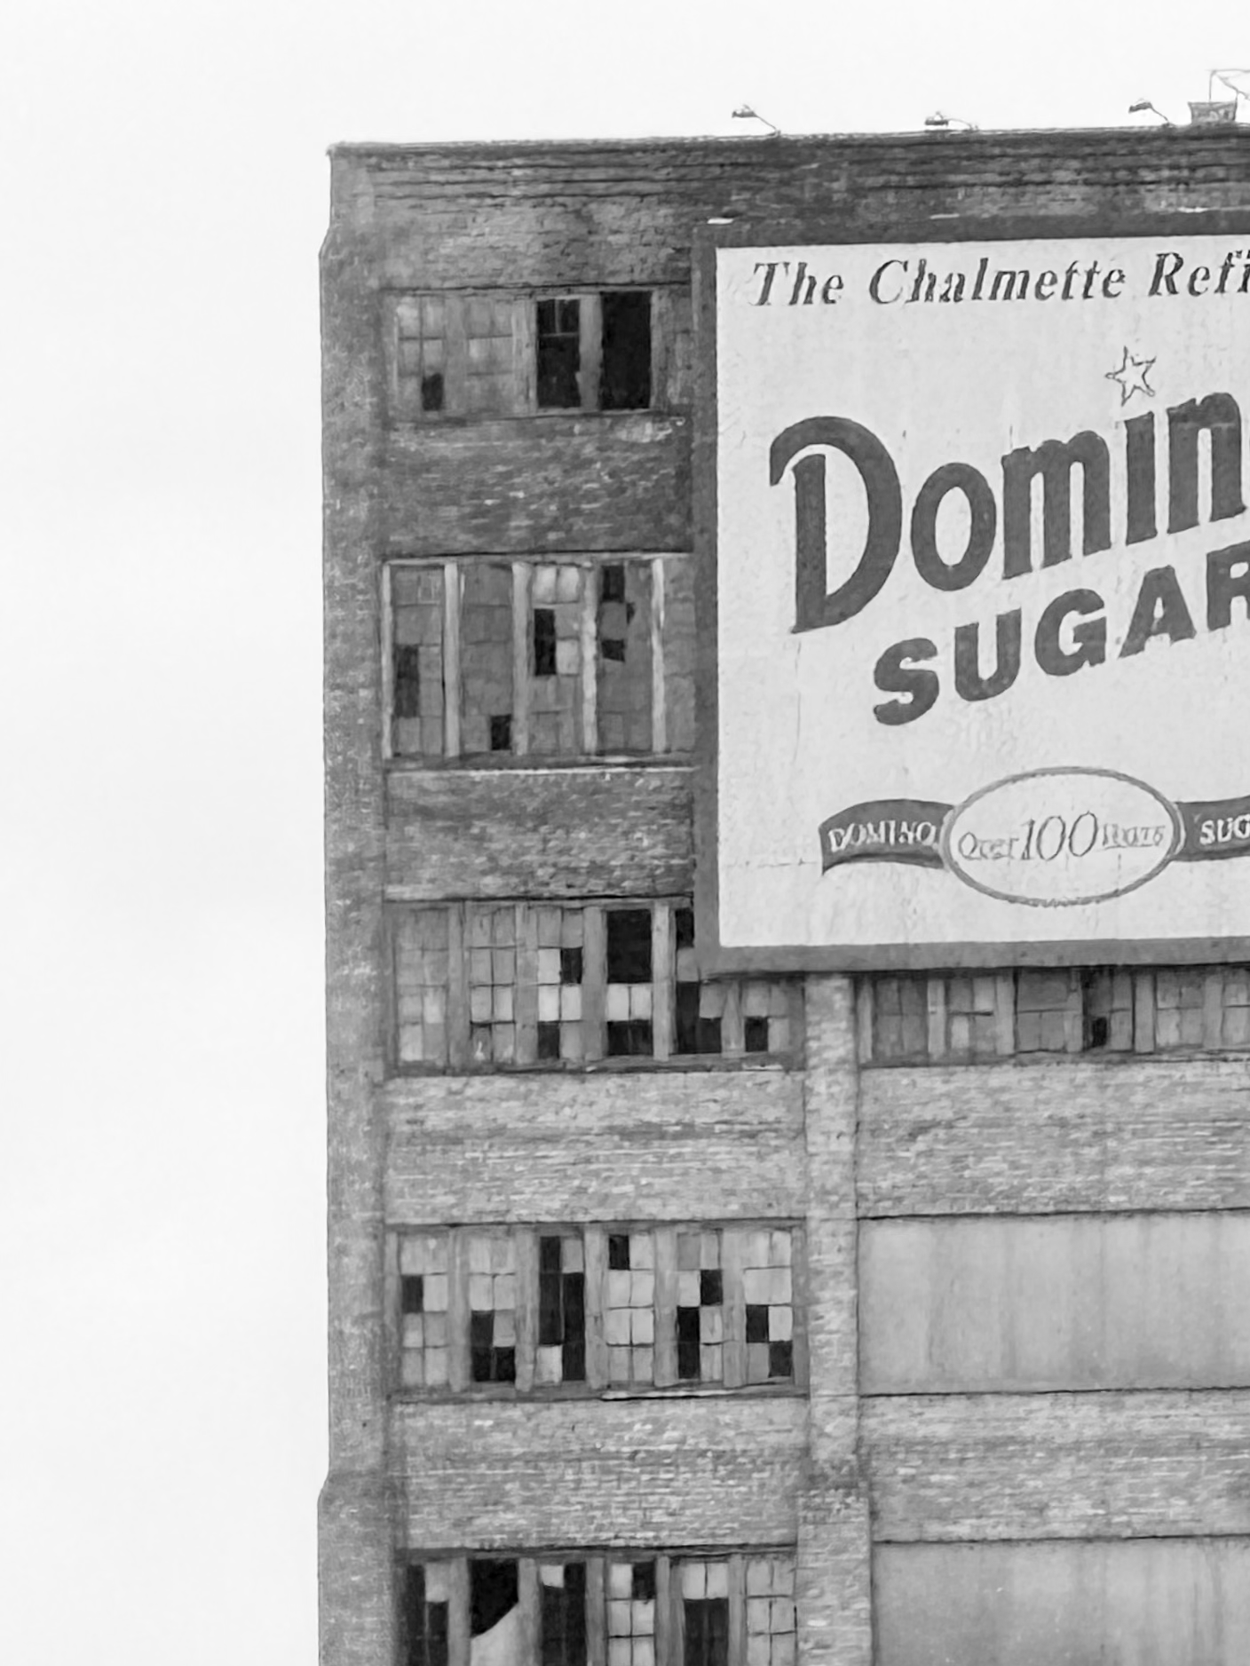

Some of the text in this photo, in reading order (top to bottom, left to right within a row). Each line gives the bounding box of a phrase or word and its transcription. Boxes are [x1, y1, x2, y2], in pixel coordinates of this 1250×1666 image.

[752, 261, 844, 306] The
[869, 258, 1127, 304] Chalmette
[828, 818, 938, 852] DOMINO
[1021, 810, 1098, 860] 100
